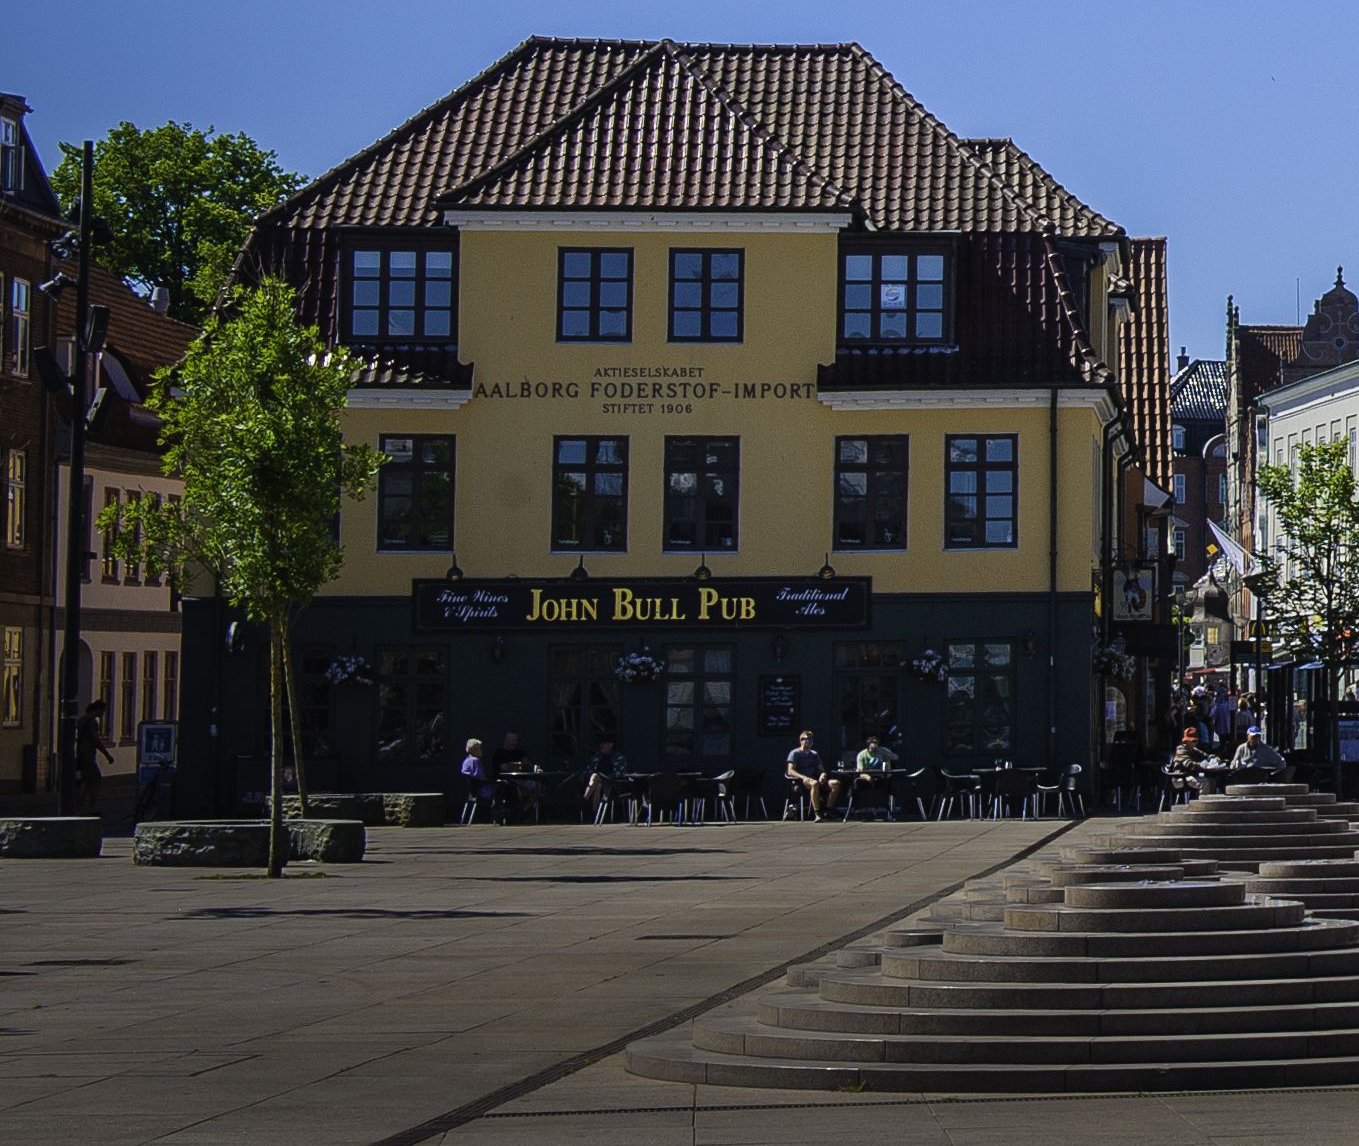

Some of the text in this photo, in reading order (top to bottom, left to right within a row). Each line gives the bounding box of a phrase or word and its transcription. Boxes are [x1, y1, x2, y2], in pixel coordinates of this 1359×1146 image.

[593, 367, 705, 379] AKTIESELSKABET
[474, 382, 816, 399] AALBORG FODERSTOF-IMPORT
[602, 404, 693, 415] STIFTET 1906
[776, 587, 849, 602] Traditional
[526, 587, 756, 621] JOHN BULL PUB
